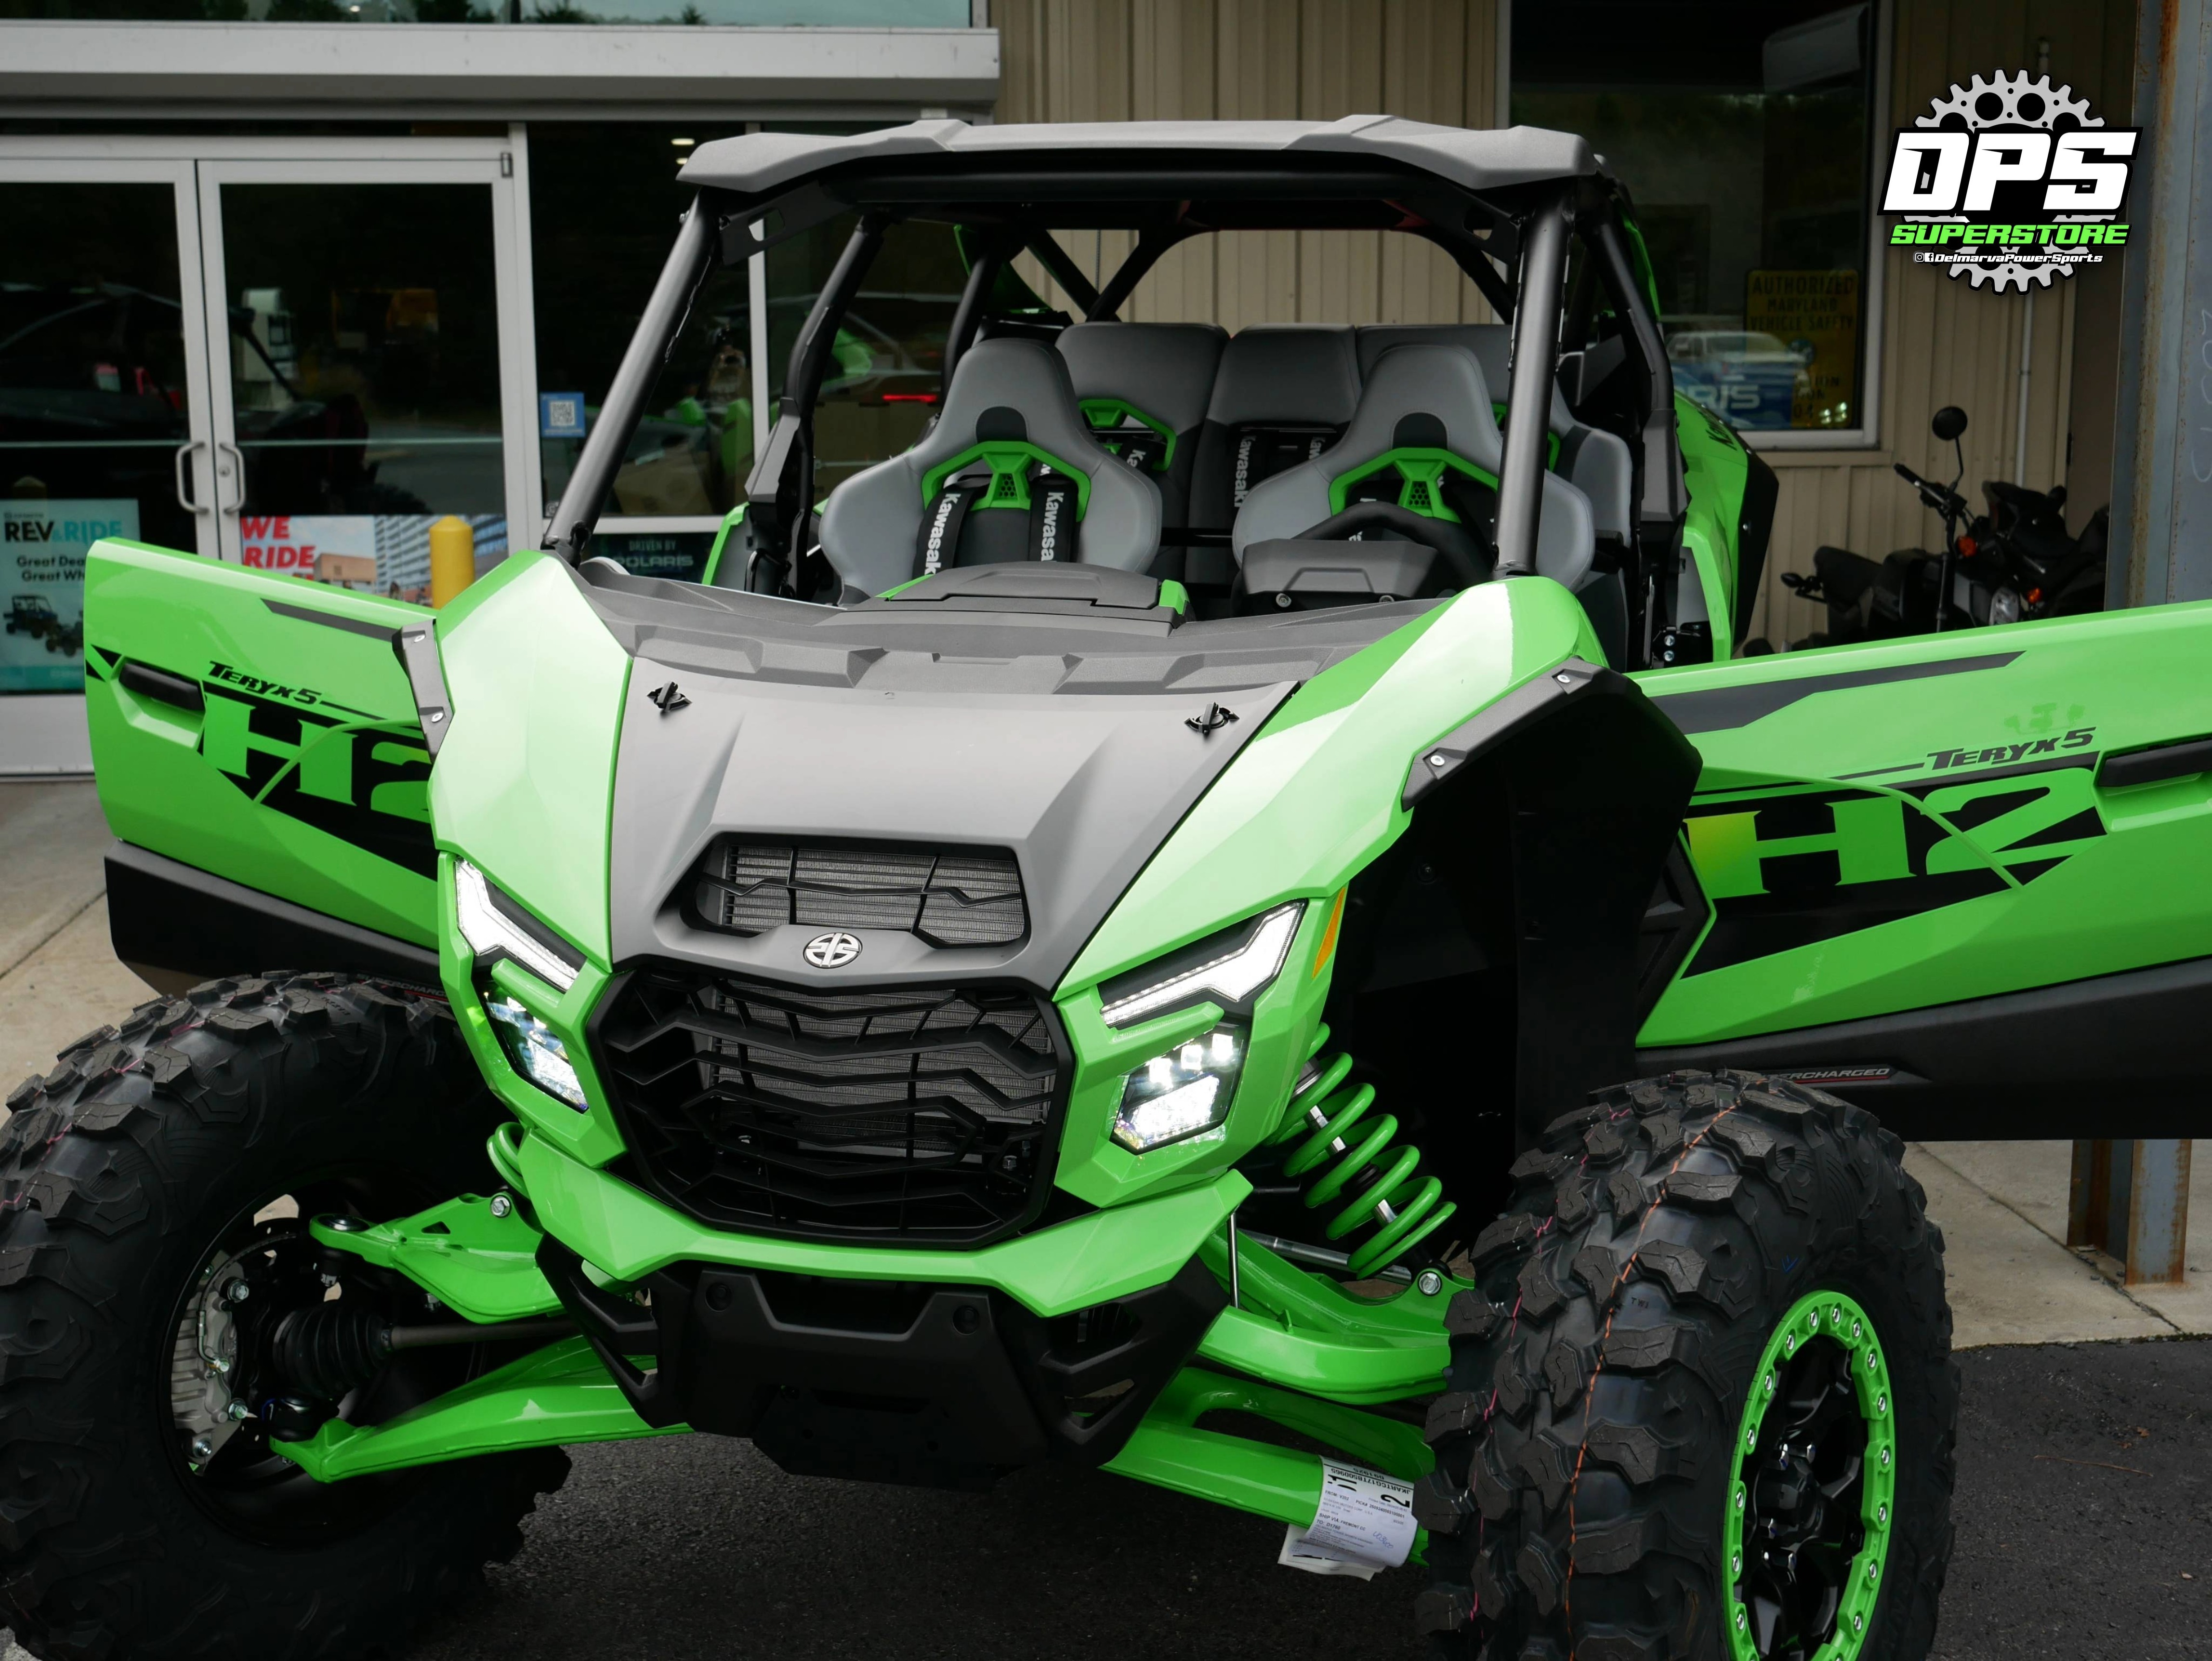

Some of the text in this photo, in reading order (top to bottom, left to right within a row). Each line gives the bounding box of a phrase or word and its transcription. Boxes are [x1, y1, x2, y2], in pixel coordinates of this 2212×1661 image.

[1752, 276, 1855, 295] AUTHORIZED
[1767, 297, 1838, 312] MARYLAND
[1750, 315, 1854, 331] VEHICLE SAFETY
[241, 515, 291, 540] WE
[924, 493, 961, 575] Kawasak
[1040, 491, 1065, 562] Kawasa
[629, 540, 676, 552] DRIVEN BY
[17, 555, 86, 567] Great Dea
[243, 545, 316, 569] RIDE
[22, 569, 85, 582] Great Wh
[1682, 767, 2109, 900] H2
